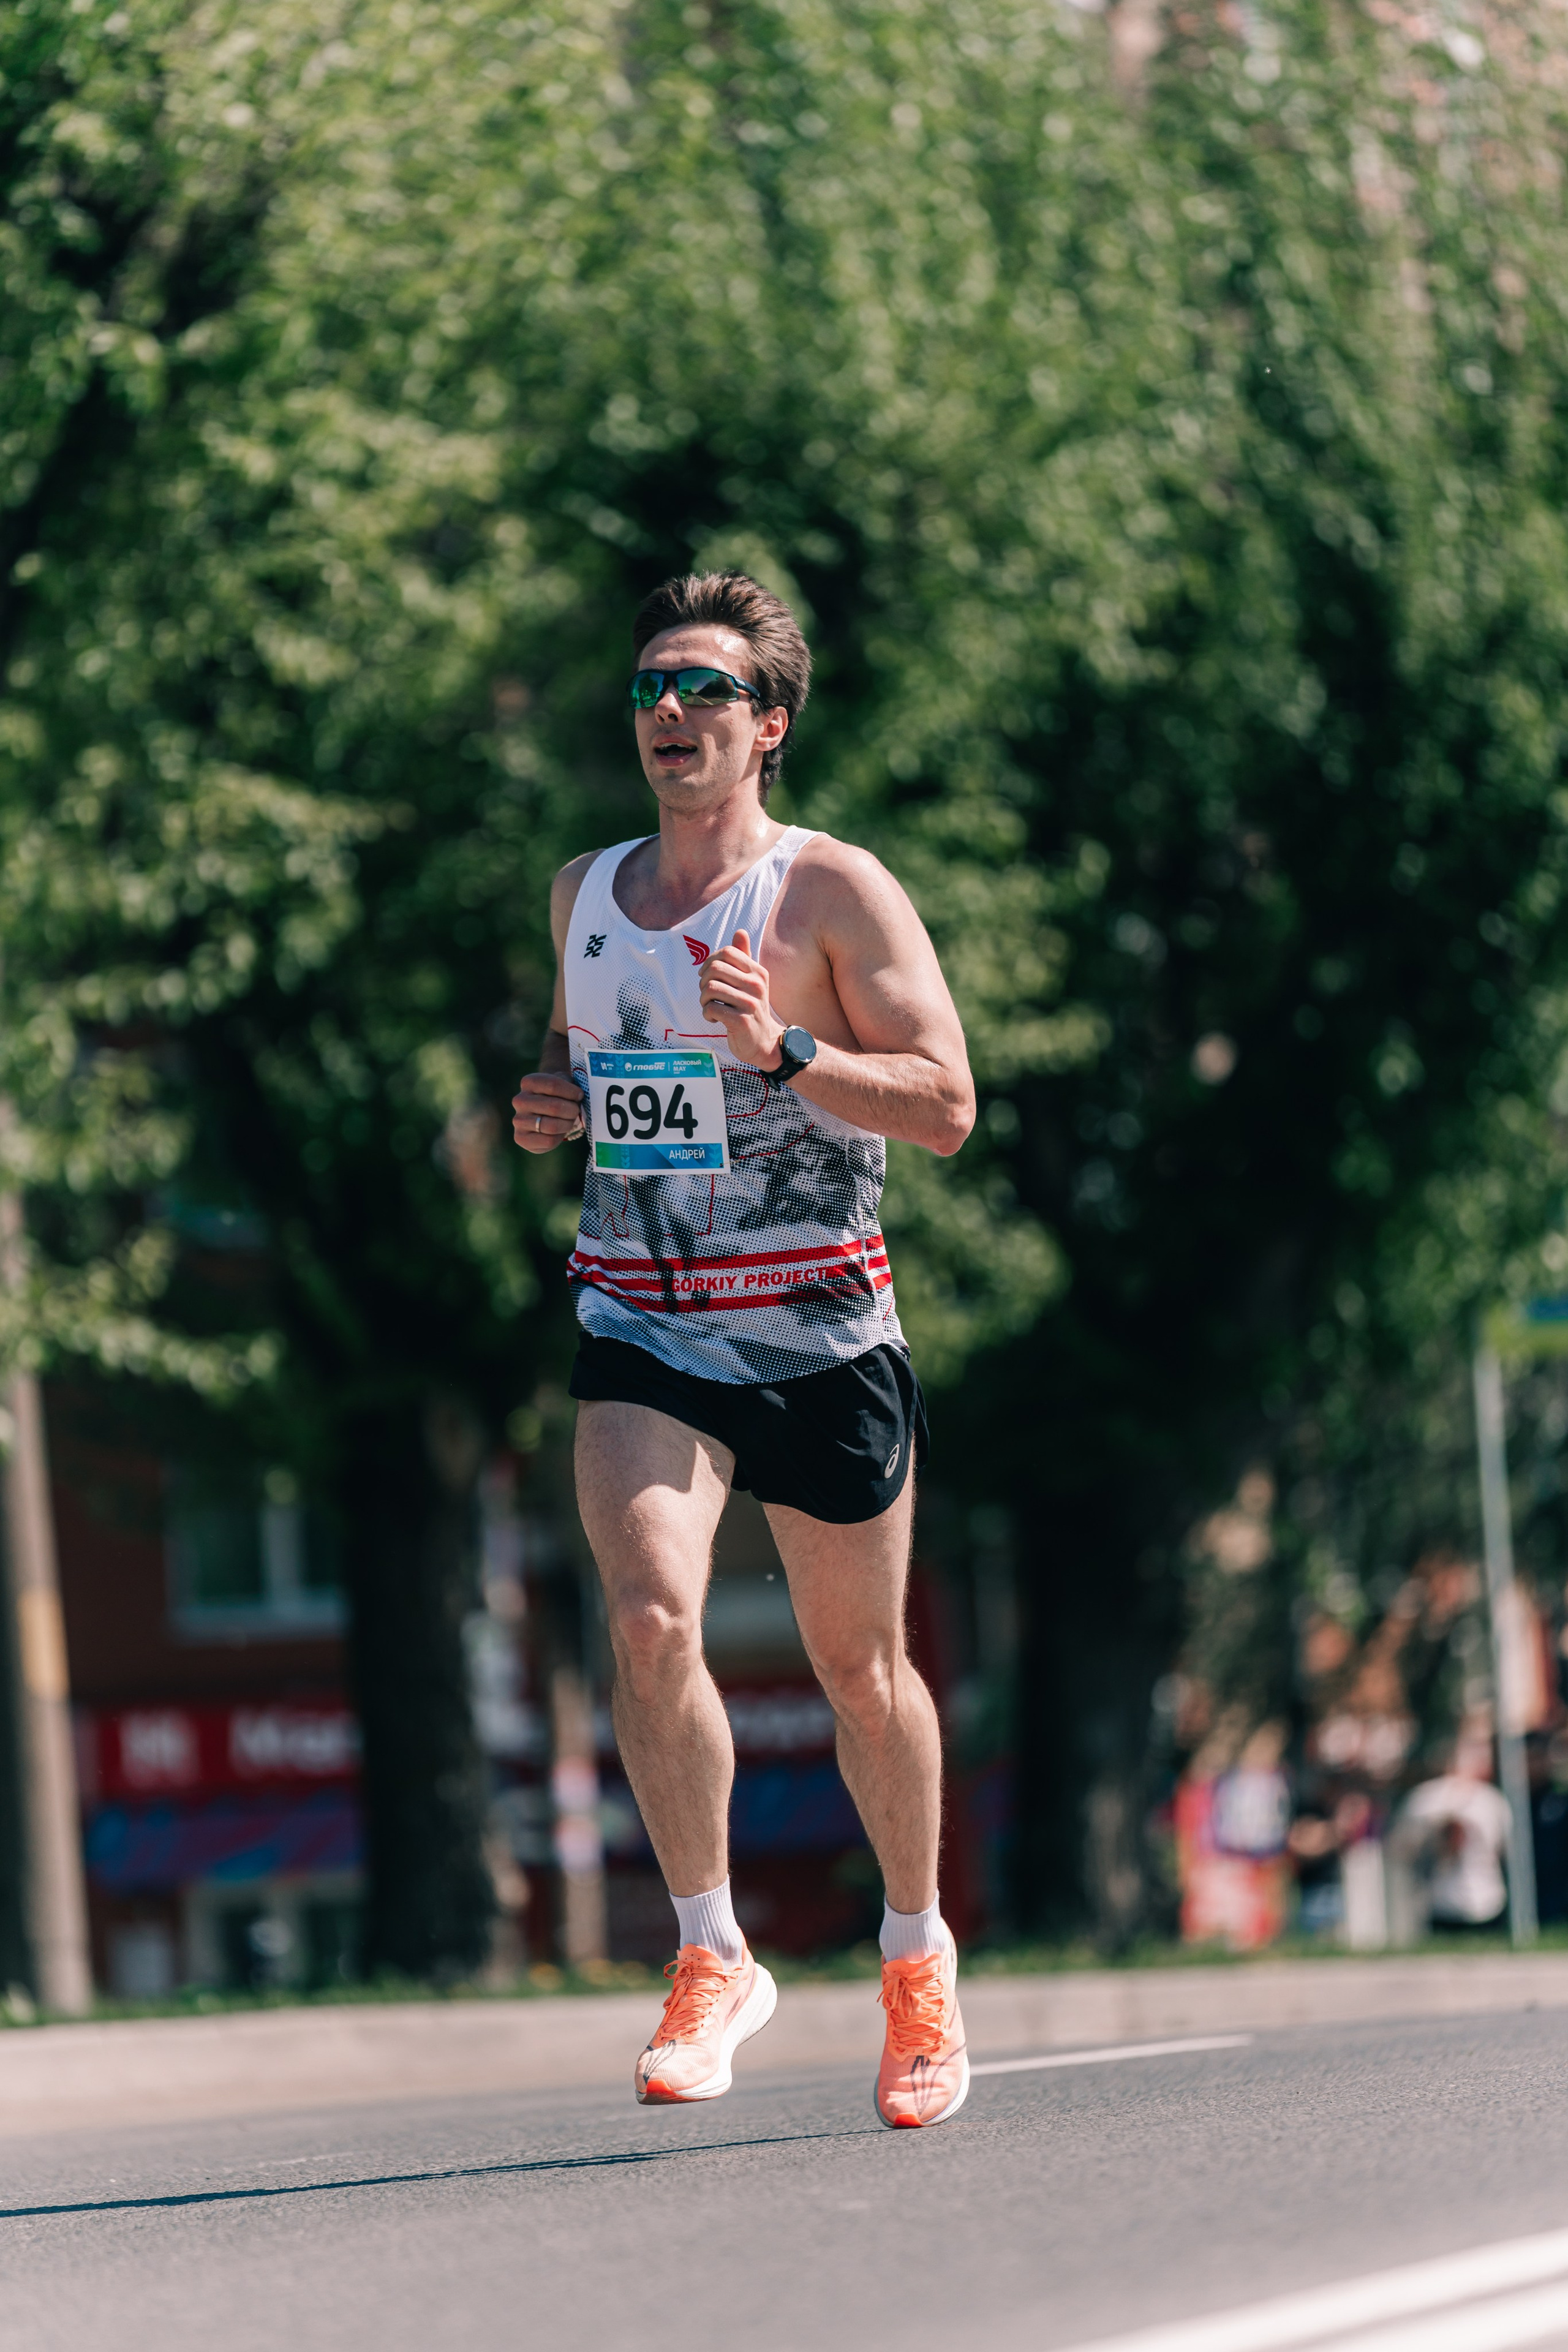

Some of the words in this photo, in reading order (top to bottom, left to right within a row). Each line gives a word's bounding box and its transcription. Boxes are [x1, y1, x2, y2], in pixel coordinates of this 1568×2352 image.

[606, 1084, 698, 1140] 694
[669, 1147, 705, 1160] АНДРЕЙ
[672, 1276, 737, 1292] GORKIY
[744, 1267, 826, 1288] PROJECT
